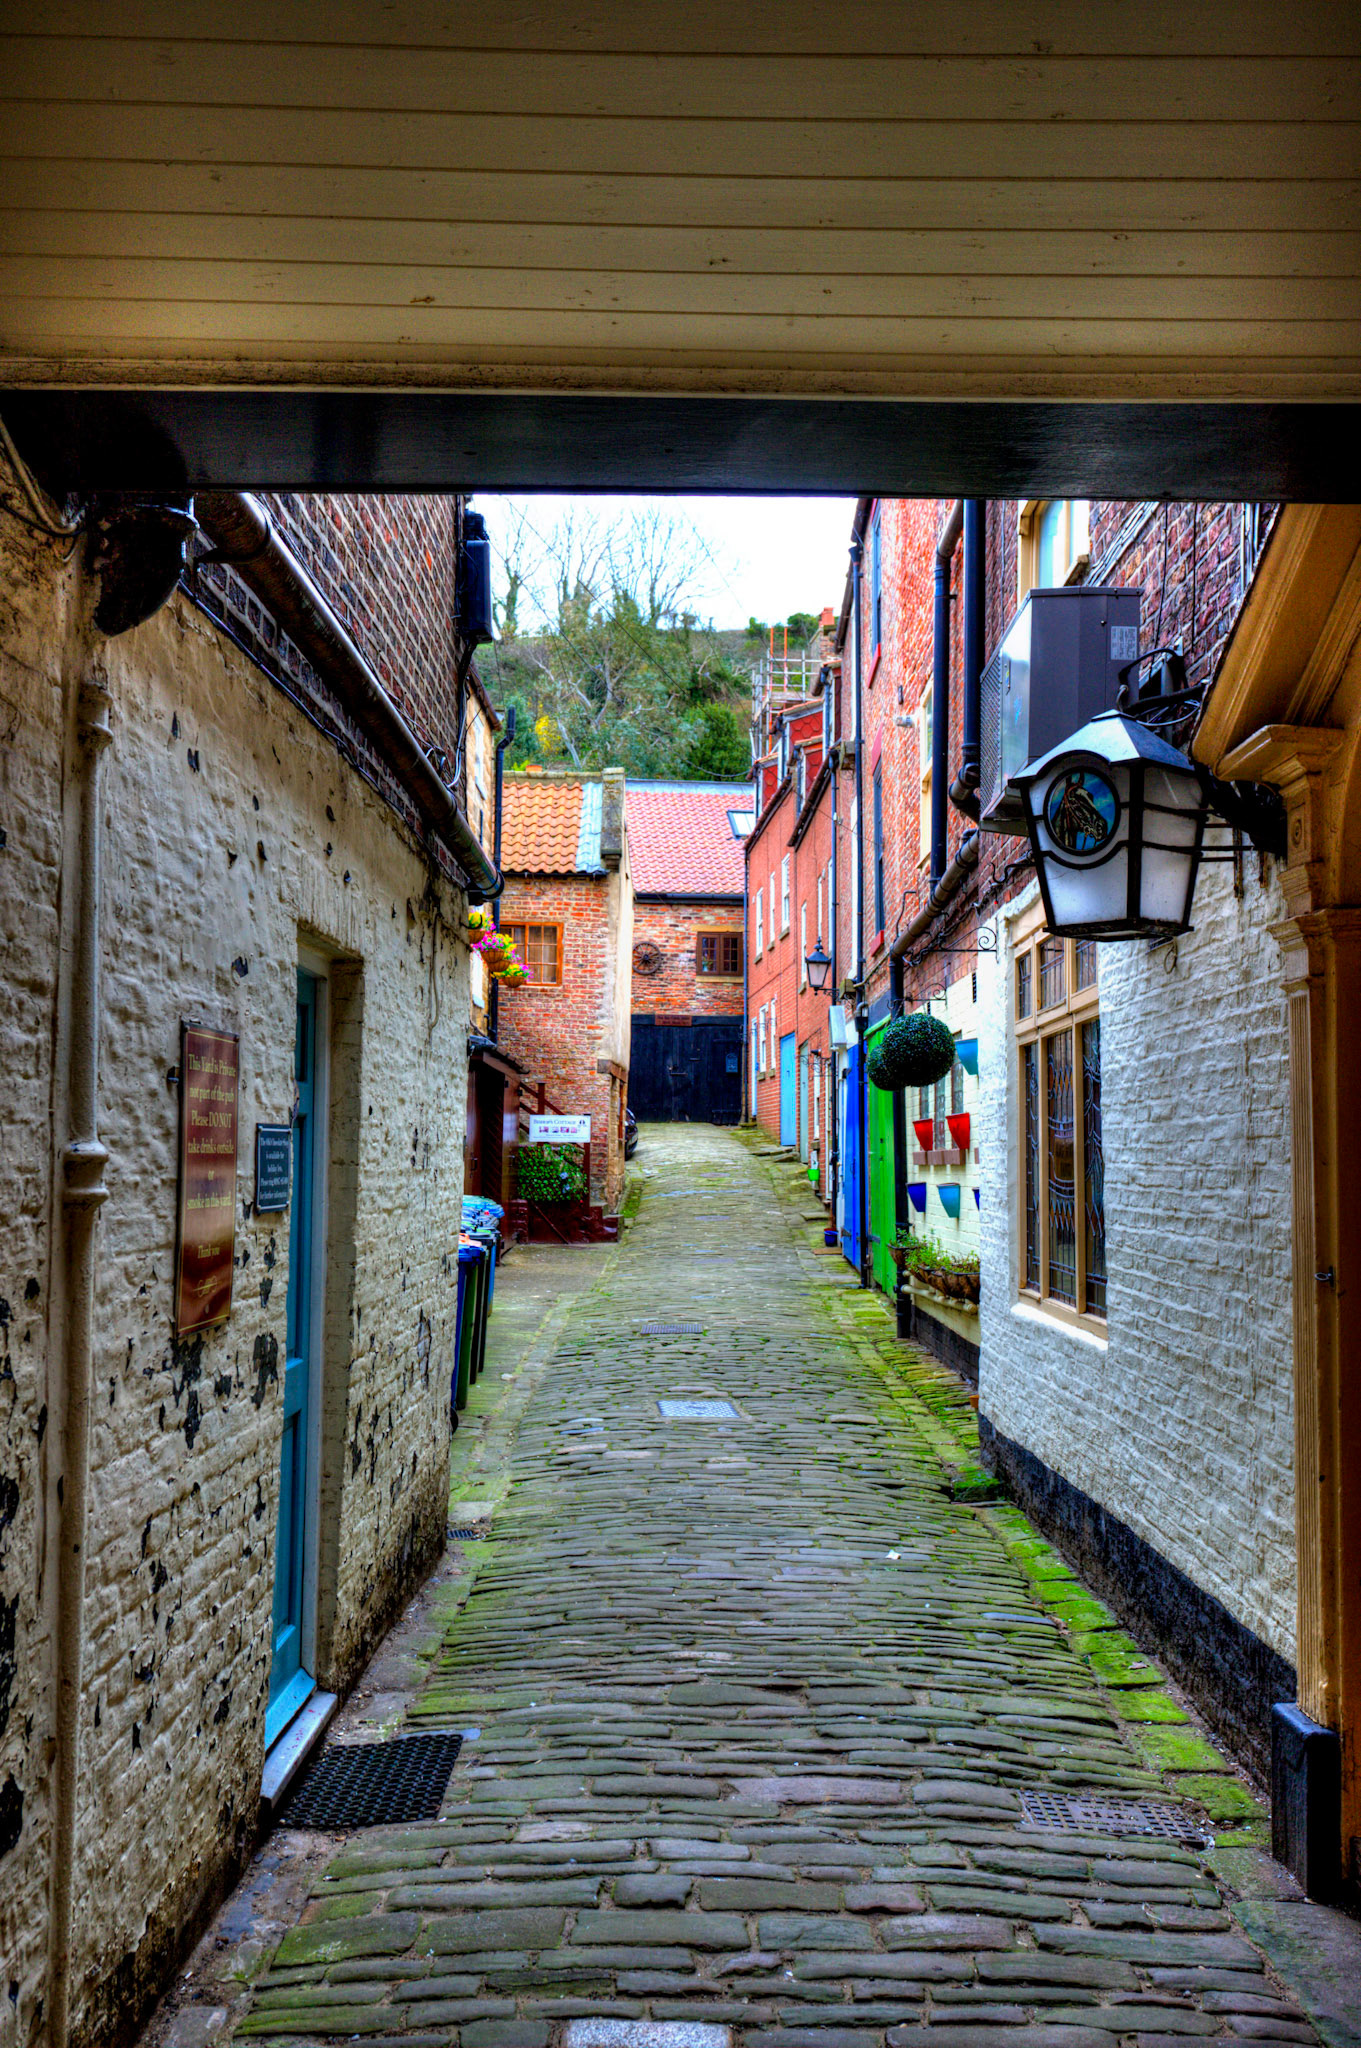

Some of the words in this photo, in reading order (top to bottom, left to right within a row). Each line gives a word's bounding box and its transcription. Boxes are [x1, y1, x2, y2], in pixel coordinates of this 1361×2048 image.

[188, 1053, 201, 1071] This
[201, 1056, 214, 1073] Yard
[219, 1059, 236, 1077] Private
[189, 1087, 199, 1098] not
[199, 1087, 210, 1103] part
[211, 1084, 217, 1100] of
[217, 1086, 225, 1101] the
[225, 1087, 234, 1106] pub
[191, 1109, 208, 1127] Please
[209, 1111, 218, 1127] DO
[219, 1112, 232, 1128] NOT
[187, 1137, 200, 1154] take
[201, 1136, 216, 1154] drinks
[217, 1138, 234, 1154] outside
[207, 1169, 214, 1181] or
[187, 1192, 204, 1209] smoke
[211, 1192, 219, 1208] this
[197, 1243, 211, 1259] Thank
[212, 1247, 220, 1259] you
